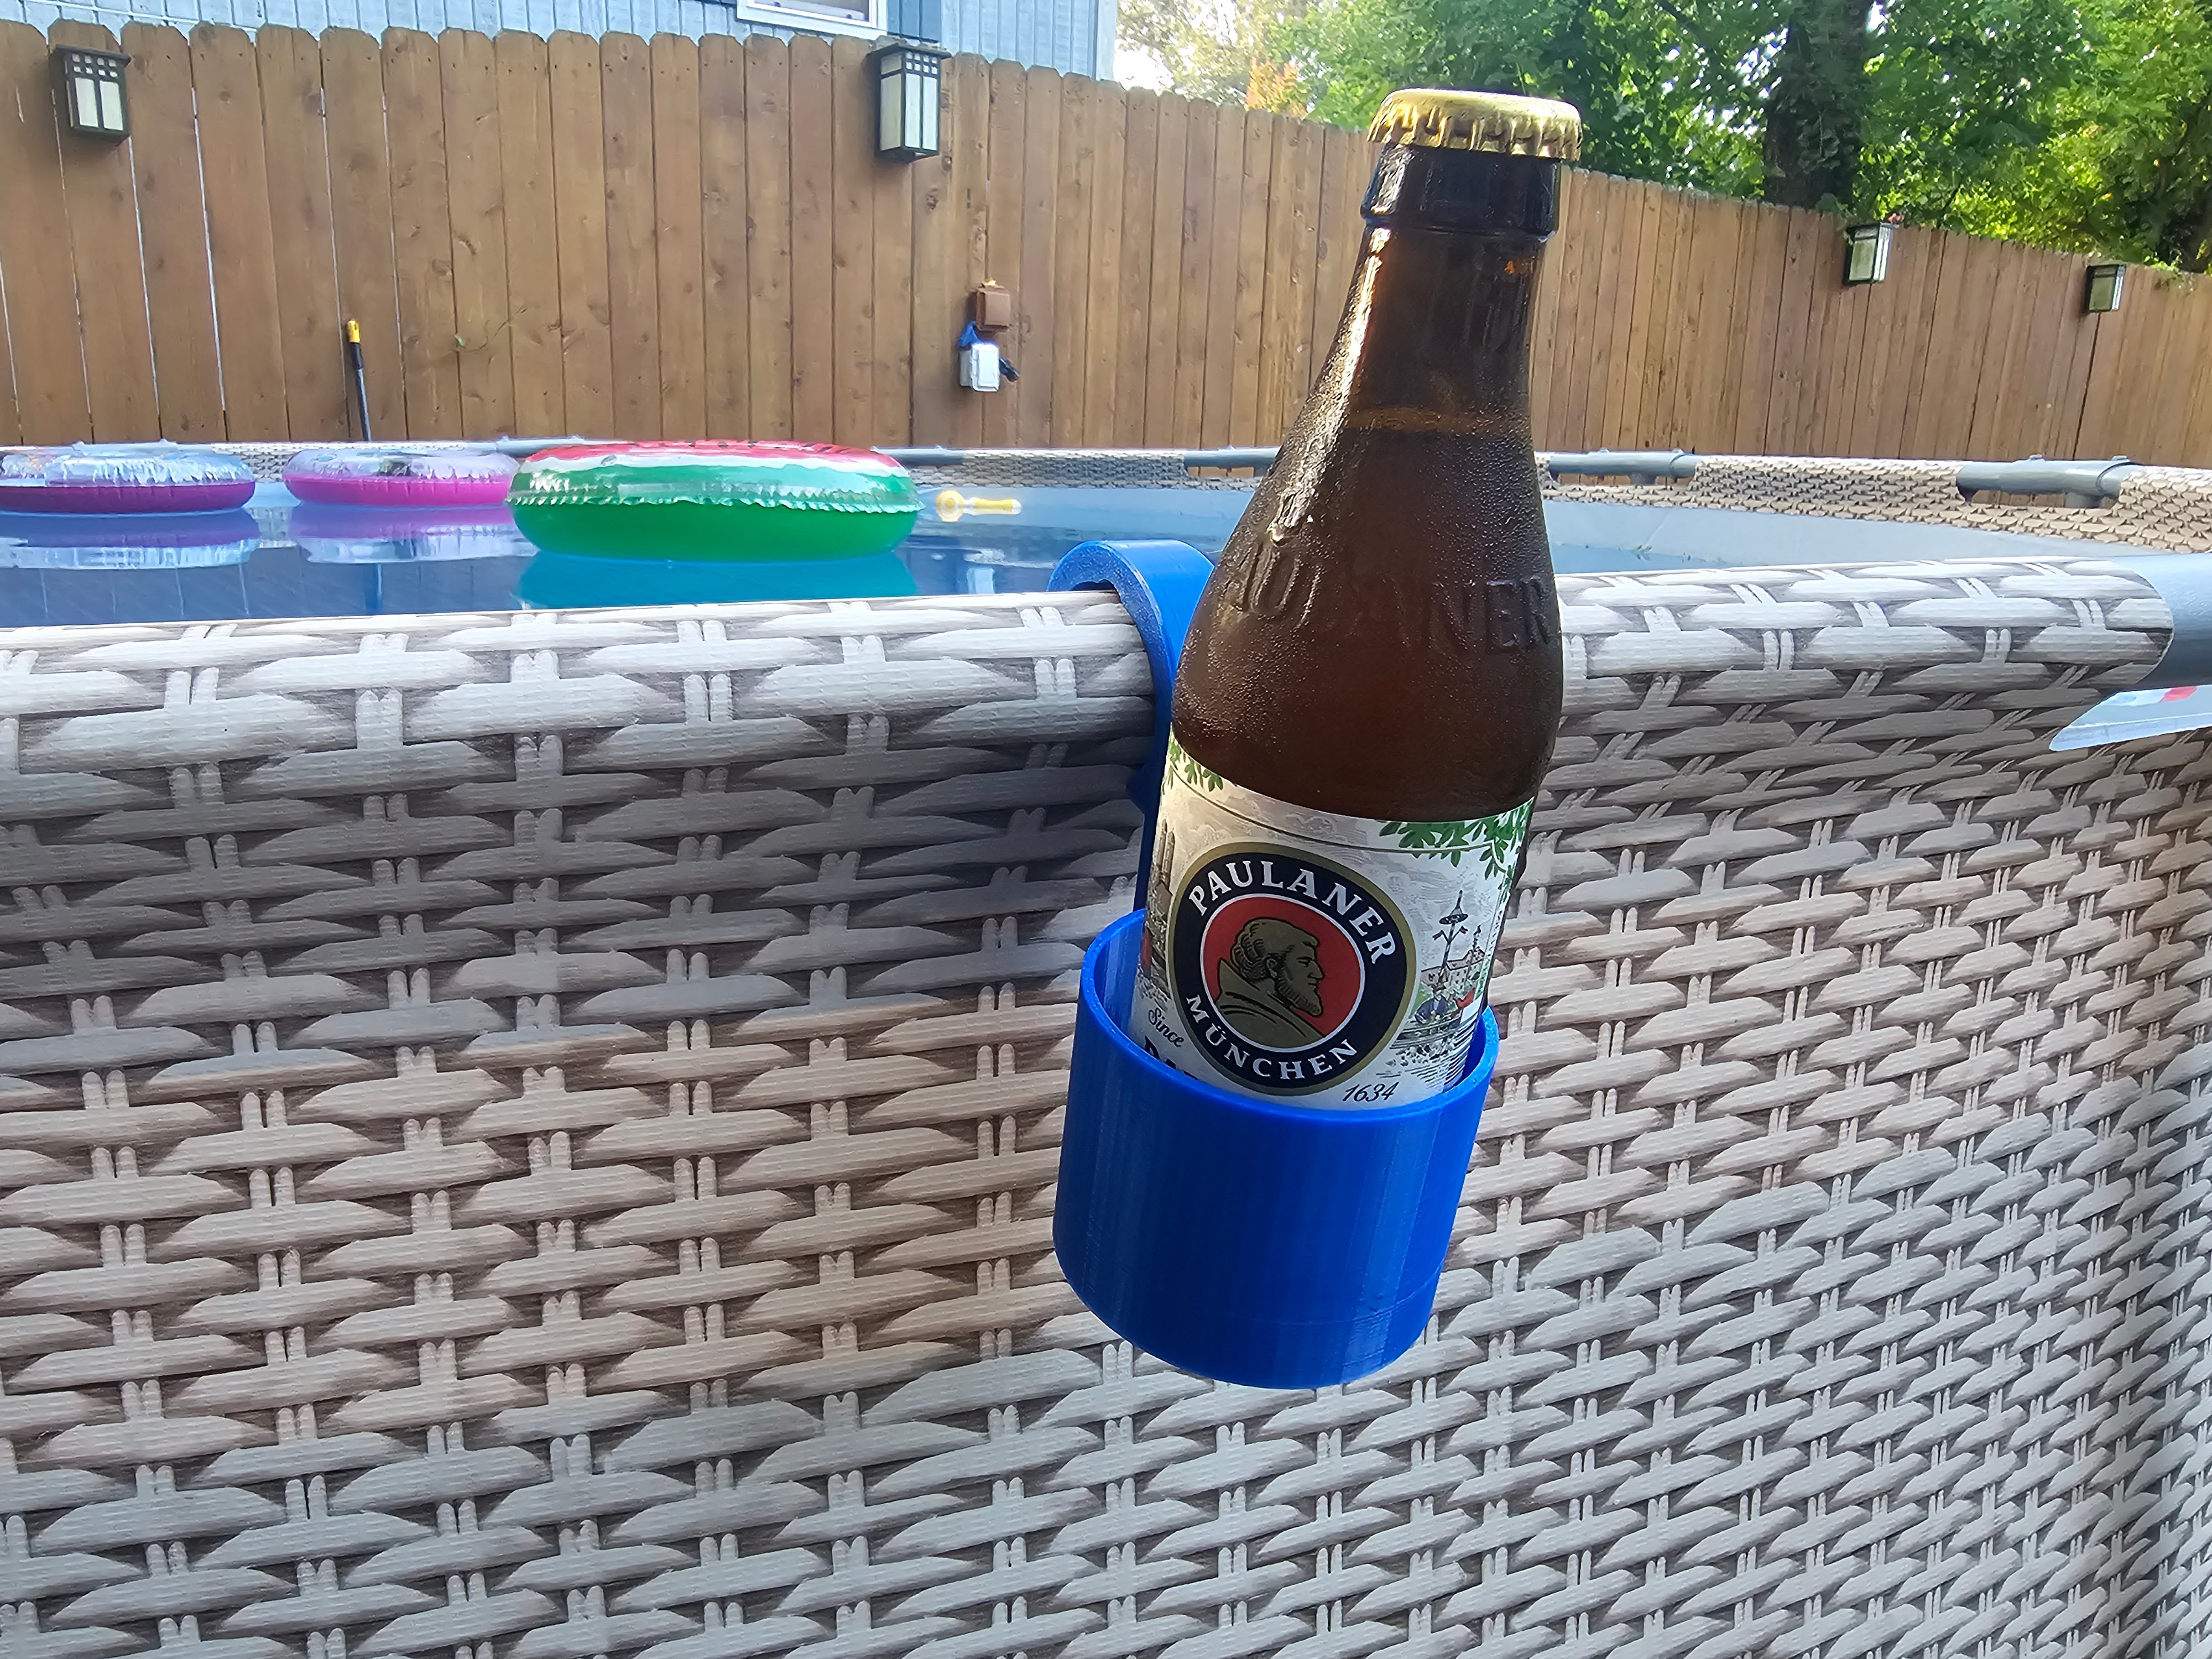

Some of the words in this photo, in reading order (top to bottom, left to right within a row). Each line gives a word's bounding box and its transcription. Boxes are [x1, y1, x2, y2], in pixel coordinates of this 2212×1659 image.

[1212, 542, 1551, 655] AULNER
[1188, 860, 1396, 964] PAULANER
[1148, 1007, 1185, 1048] Since
[1186, 994, 1358, 1080] MÜNCHEN
[1342, 1082, 1400, 1102] 1634
